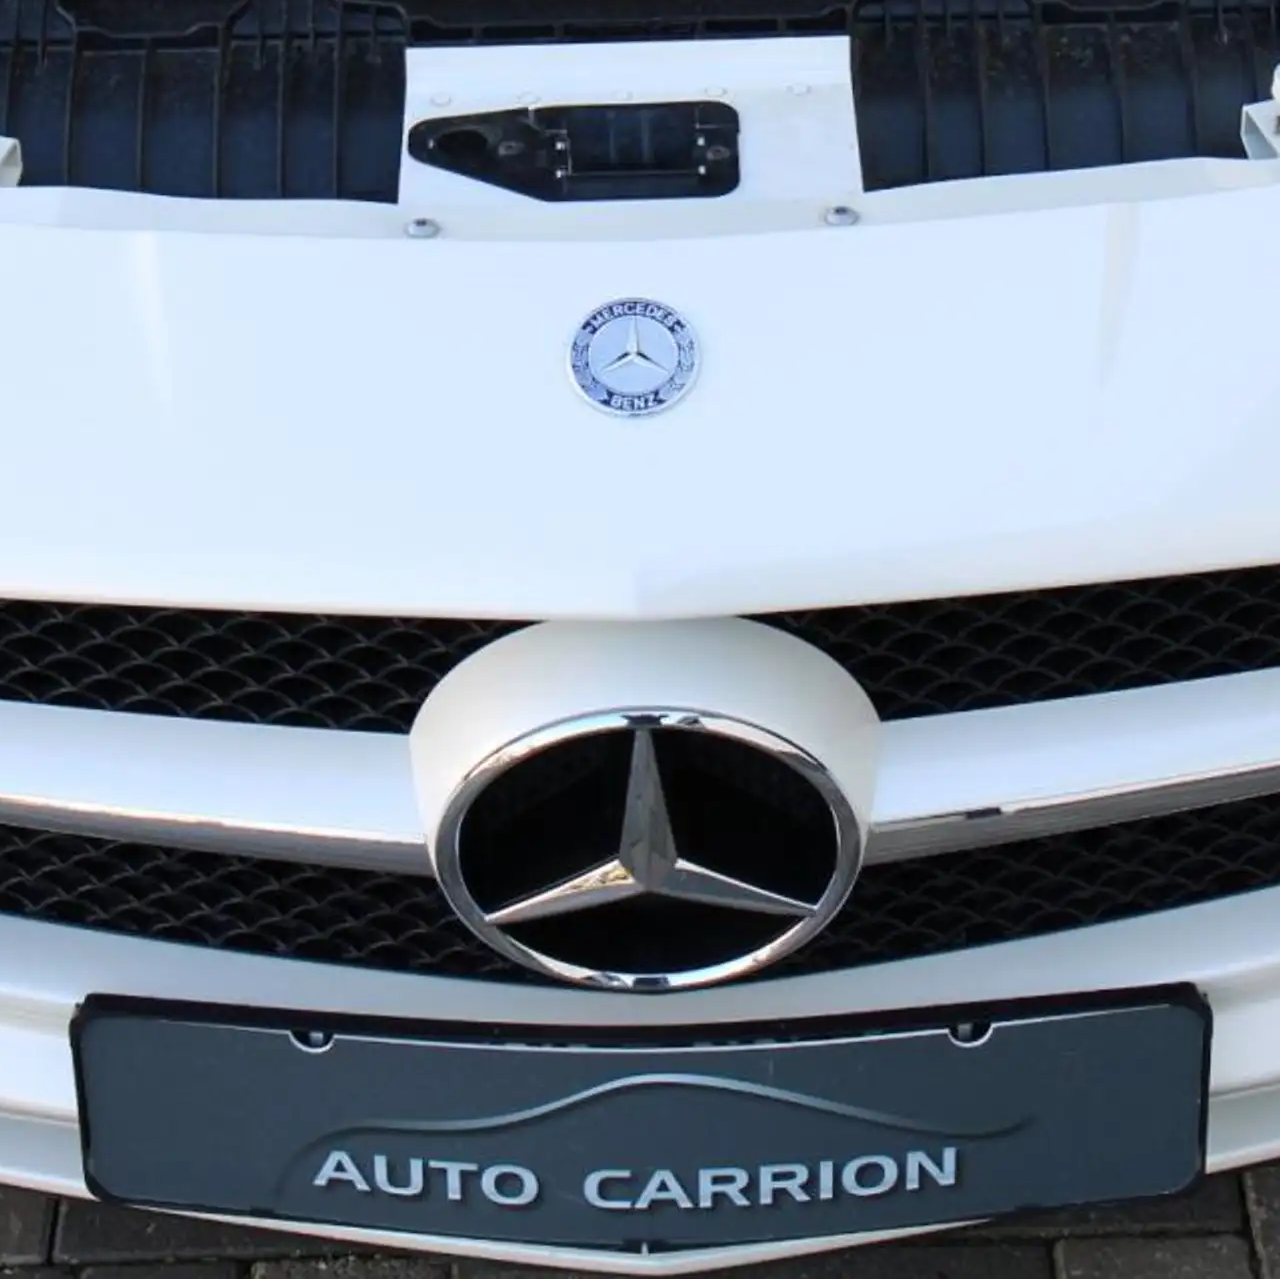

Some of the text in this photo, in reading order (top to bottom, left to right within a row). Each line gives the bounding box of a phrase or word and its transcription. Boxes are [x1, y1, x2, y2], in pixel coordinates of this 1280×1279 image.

[588, 301, 678, 327] MERCEDES
[609, 395, 658, 411] BENZ
[313, 1147, 958, 1209] AUTO CARRION
